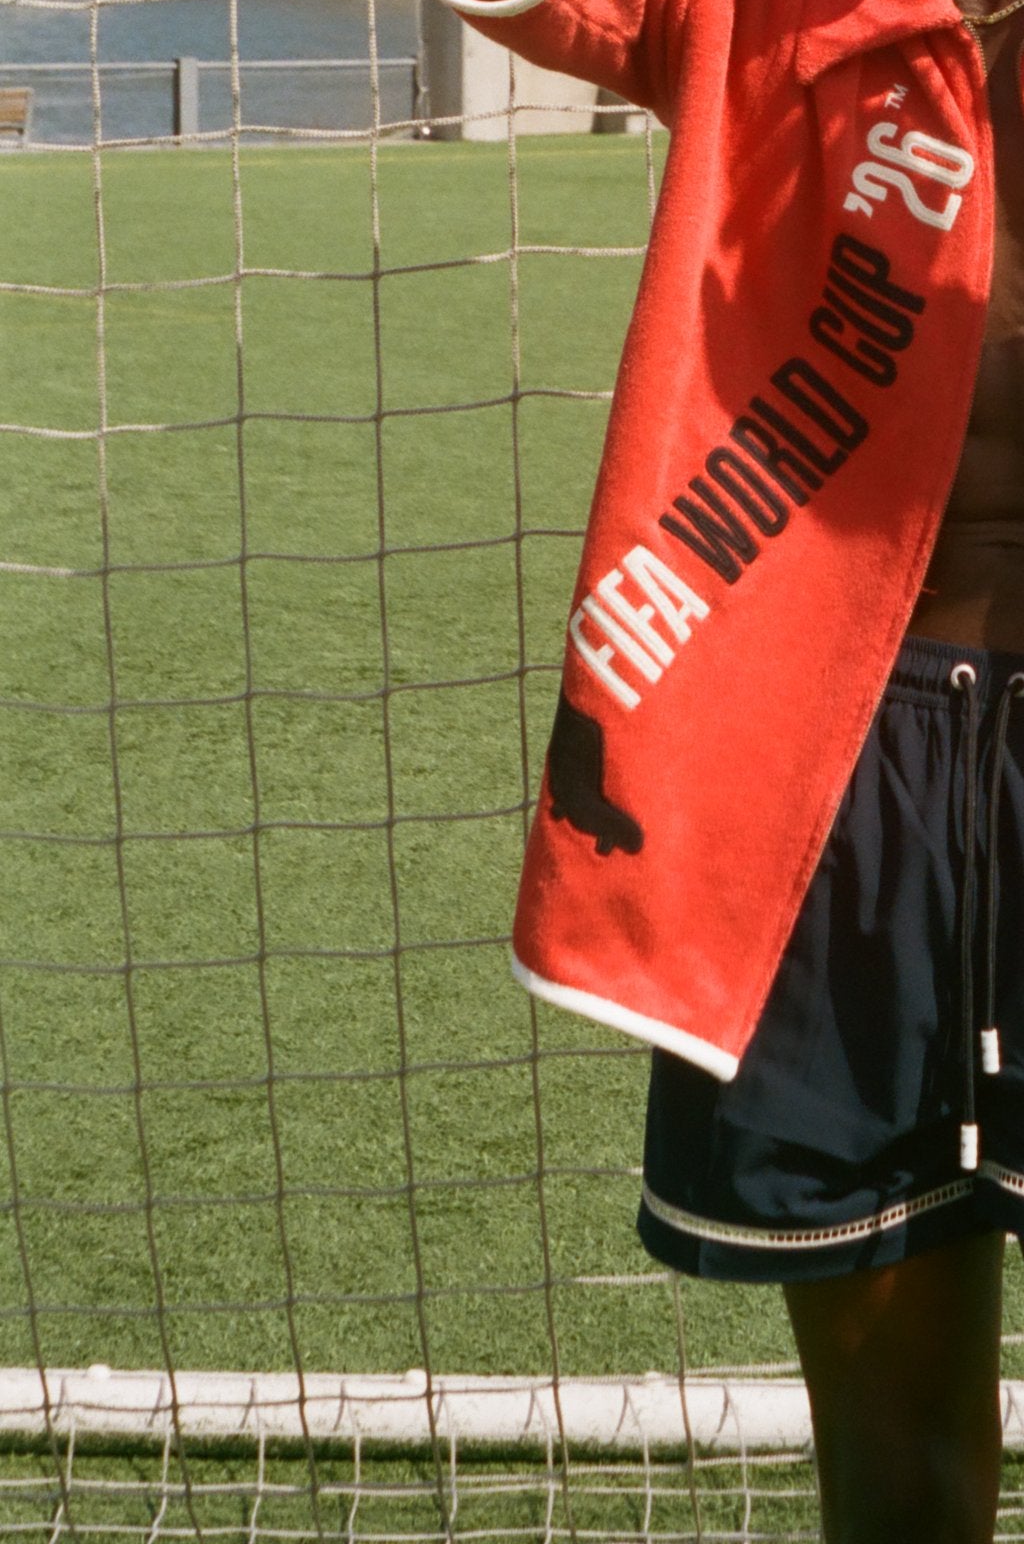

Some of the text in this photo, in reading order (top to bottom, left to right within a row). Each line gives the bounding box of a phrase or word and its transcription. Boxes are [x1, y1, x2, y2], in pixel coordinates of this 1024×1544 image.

[569, 544, 711, 711] FIFA
[659, 358, 870, 586] WORLD
[809, 233, 925, 388] CUP
